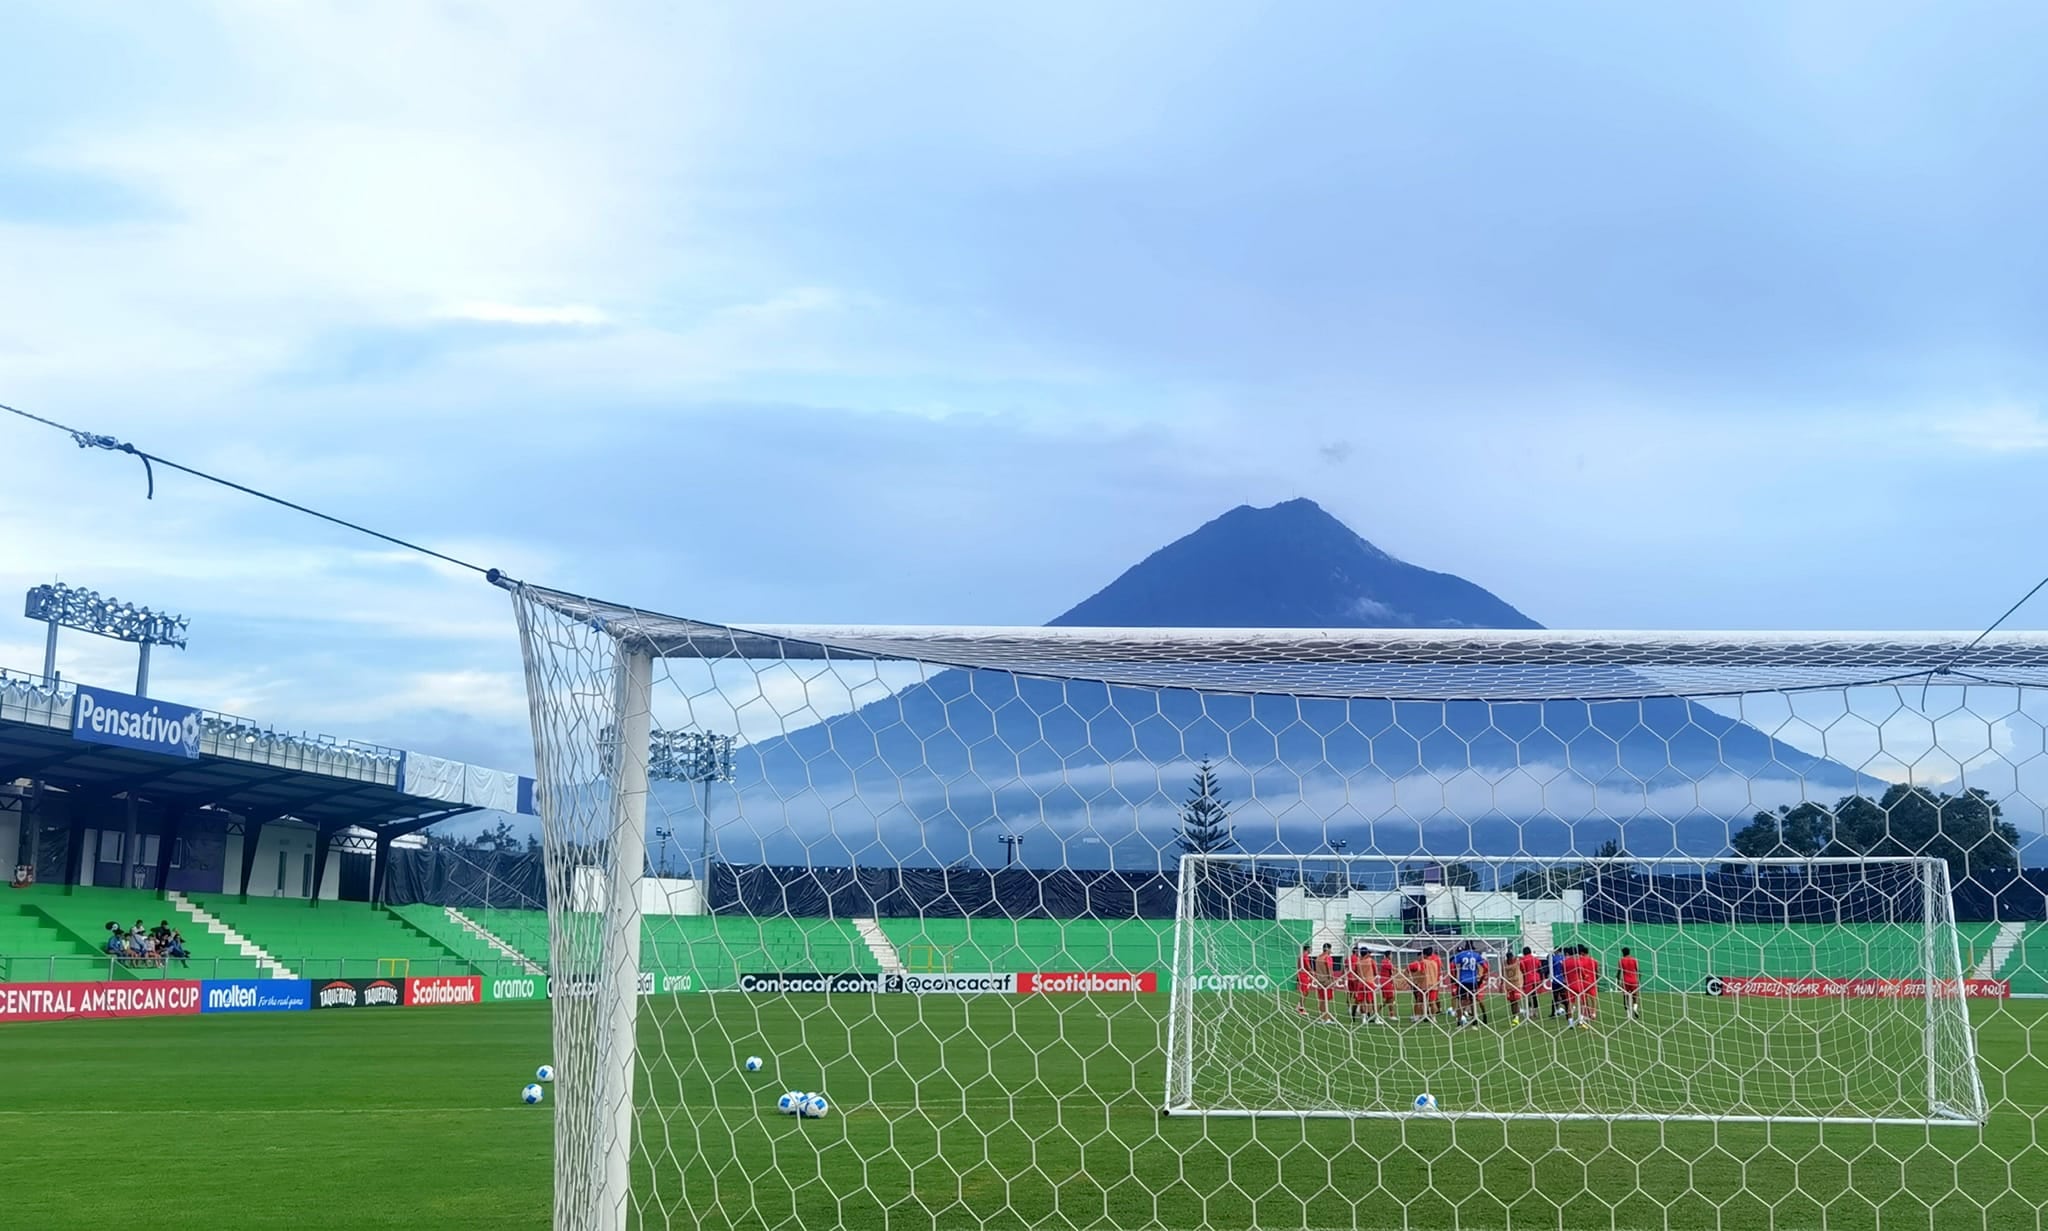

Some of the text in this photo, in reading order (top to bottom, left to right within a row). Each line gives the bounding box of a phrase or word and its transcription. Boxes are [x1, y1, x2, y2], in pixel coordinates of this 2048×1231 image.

[77, 693, 182, 745] Pensativo
[1462, 957, 1477, 971] 28
[412, 979, 475, 1004] Scotiabank
[493, 979, 535, 998] aramco
[663, 975, 692, 991] aramco
[740, 974, 877, 993] Concacaf.com
[905, 974, 1011, 992] @concacaf
[1031, 973, 1143, 992] Scotiabank
[80, 988, 165, 1011] AMERICAN
[168, 987, 199, 1009] CUP
[208, 985, 257, 1008] molten
[320, 987, 357, 1007] TAQUERITOS
[363, 986, 399, 1005] TAQUERITOS
